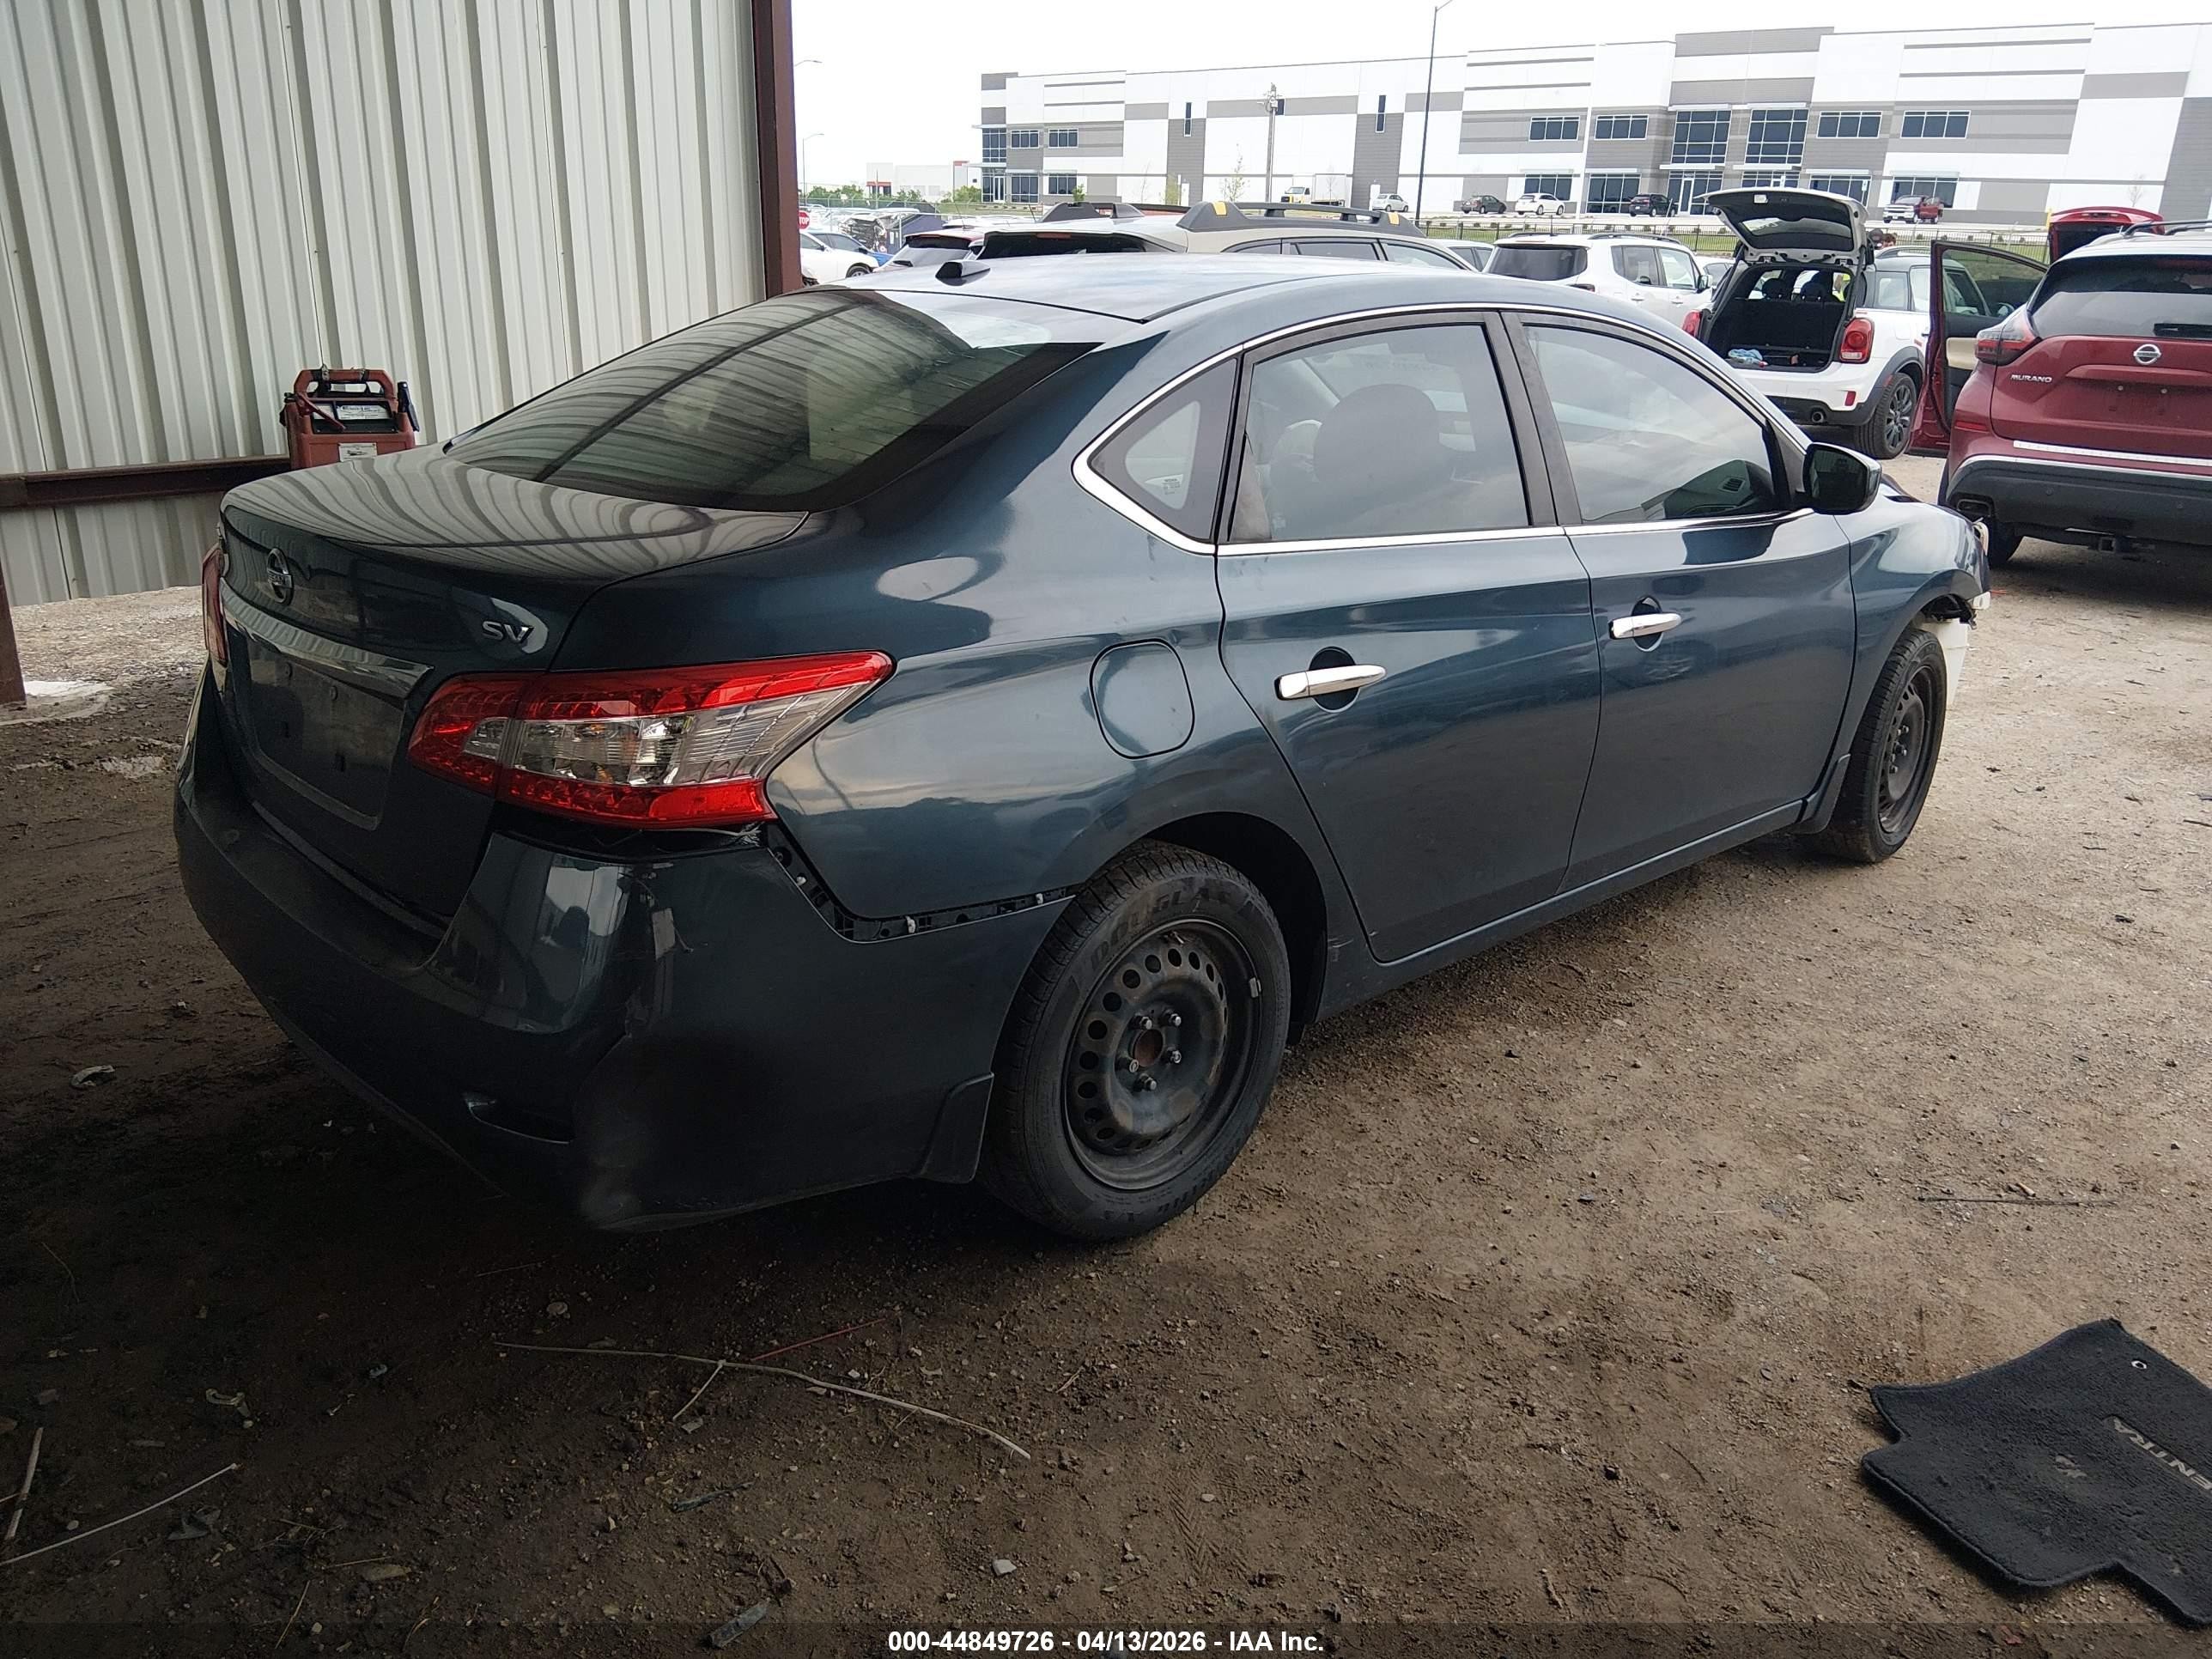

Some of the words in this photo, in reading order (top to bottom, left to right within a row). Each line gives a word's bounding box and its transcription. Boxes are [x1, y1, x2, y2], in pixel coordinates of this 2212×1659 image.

[799, 216, 809, 225] TOP
[2010, 374, 2052, 384] MURANO
[483, 621, 534, 643] SV
[2113, 1417, 2212, 1490] ENTRA
